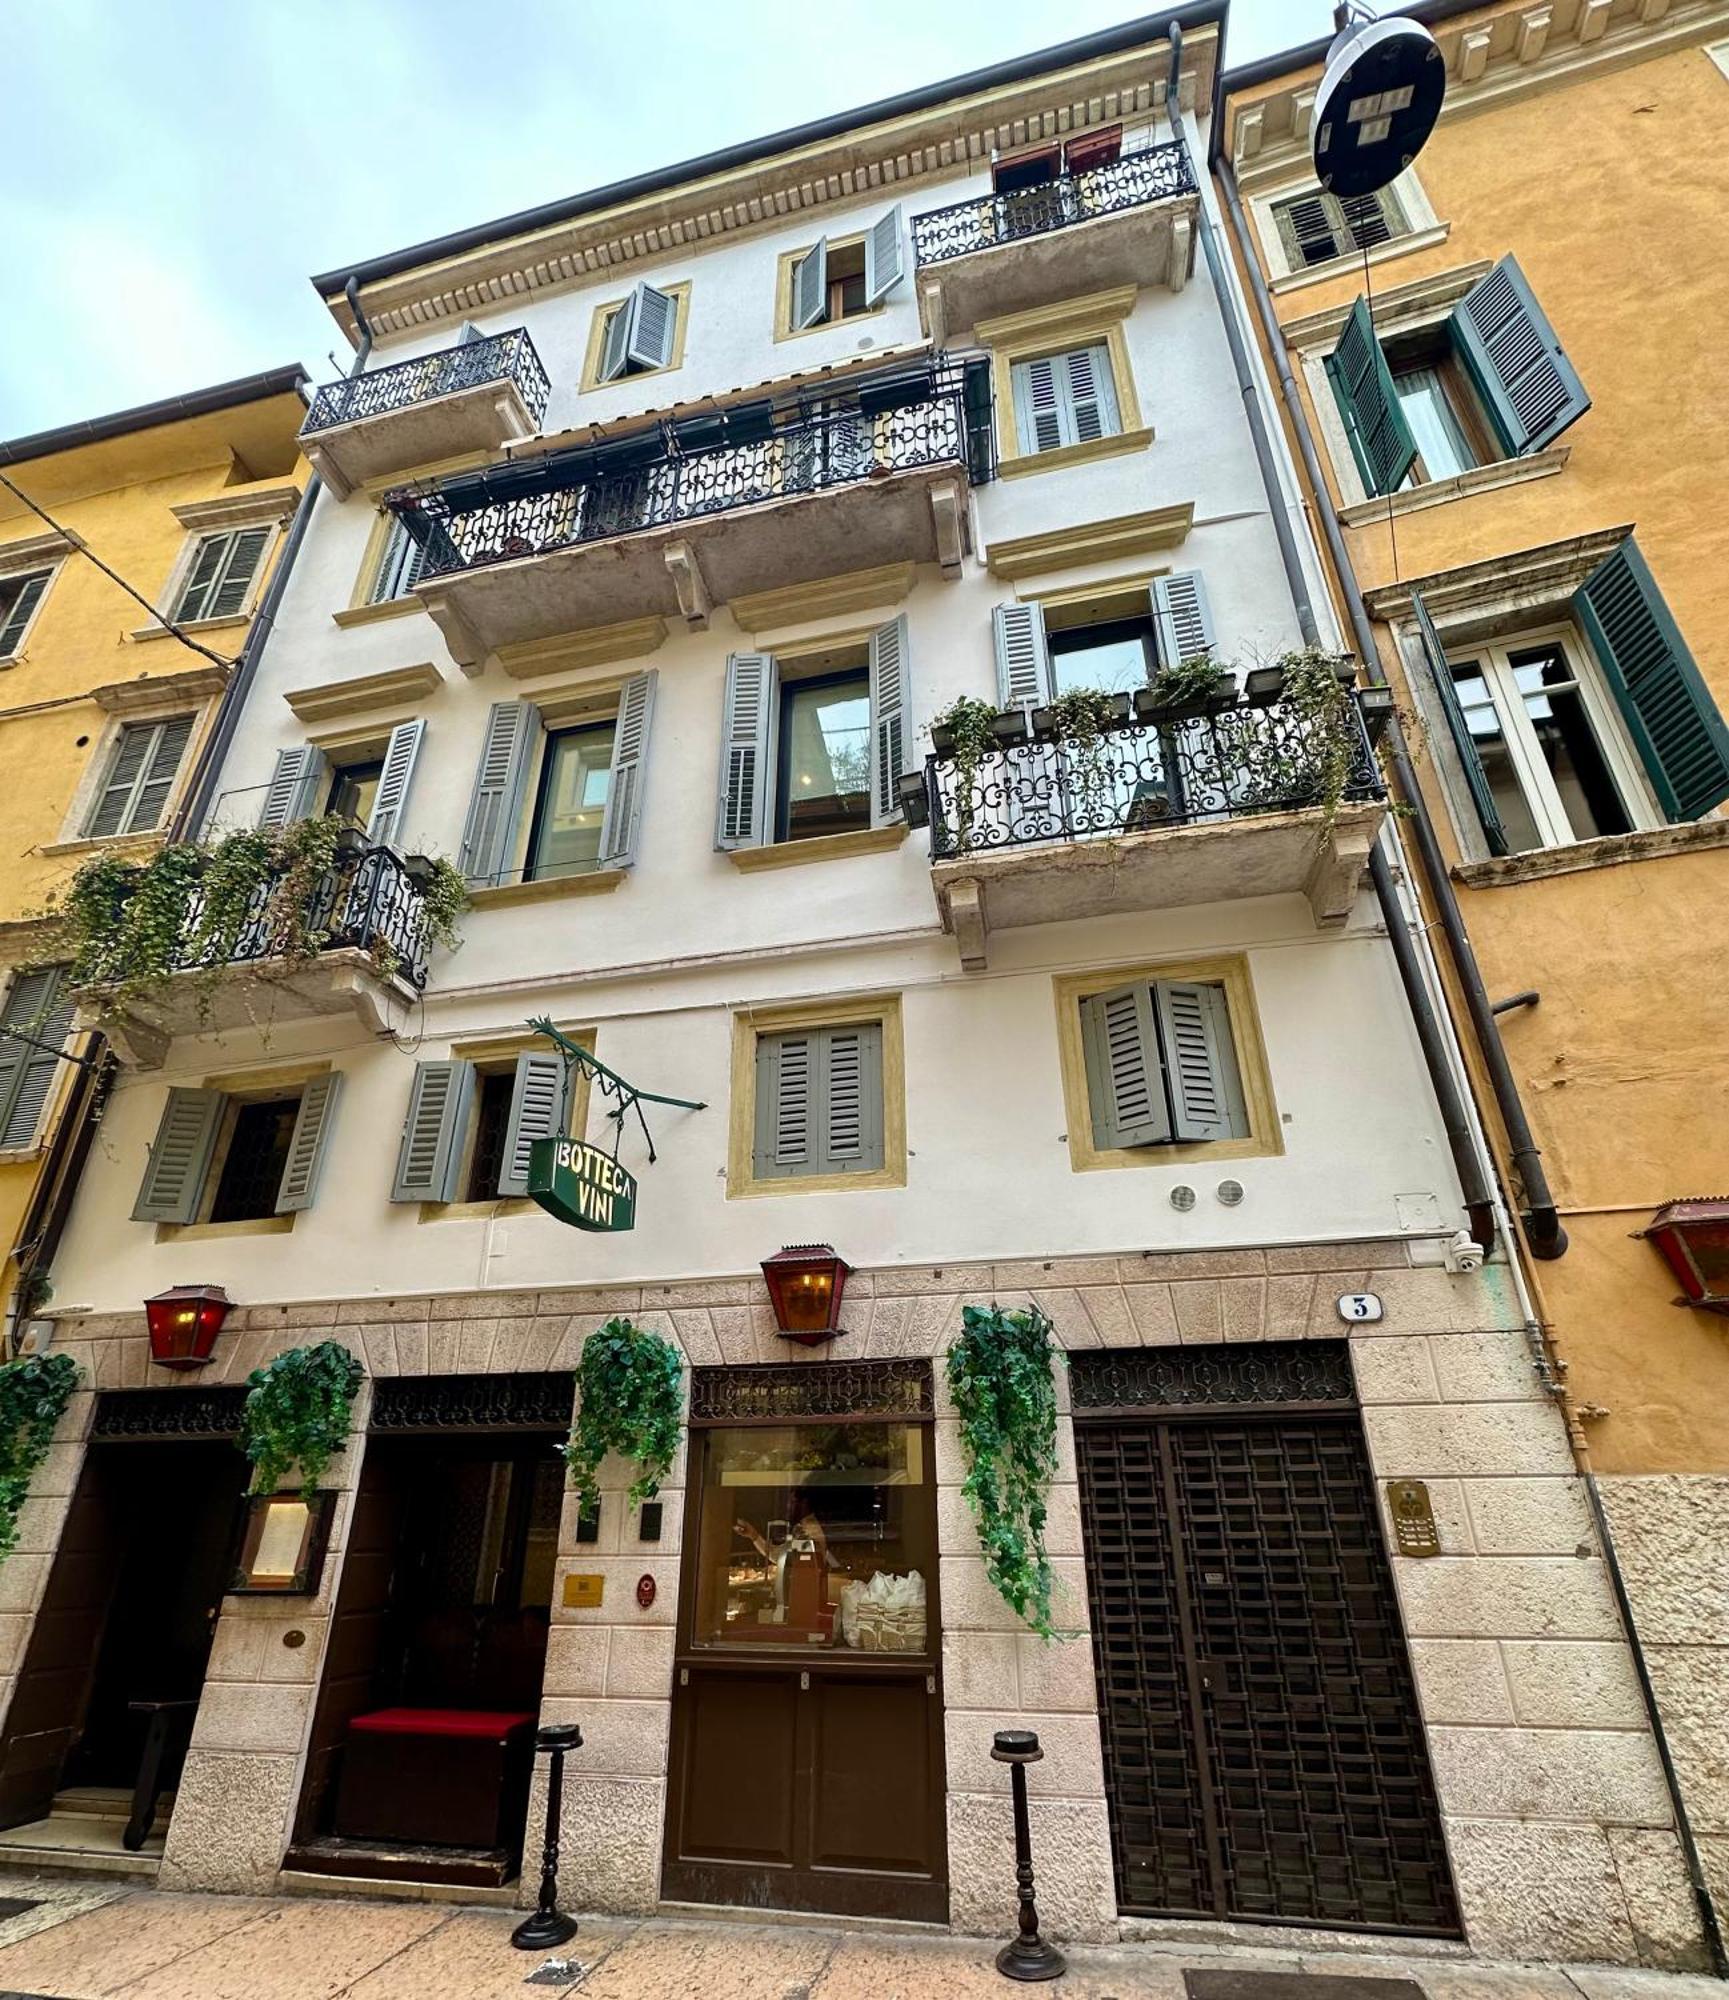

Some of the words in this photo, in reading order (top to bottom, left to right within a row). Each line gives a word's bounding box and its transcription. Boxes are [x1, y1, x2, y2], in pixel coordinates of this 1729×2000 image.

[557, 1141, 632, 1201] BOTTEGA
[579, 1180, 614, 1226] VINI
[1353, 1297, 1368, 1317] 3
